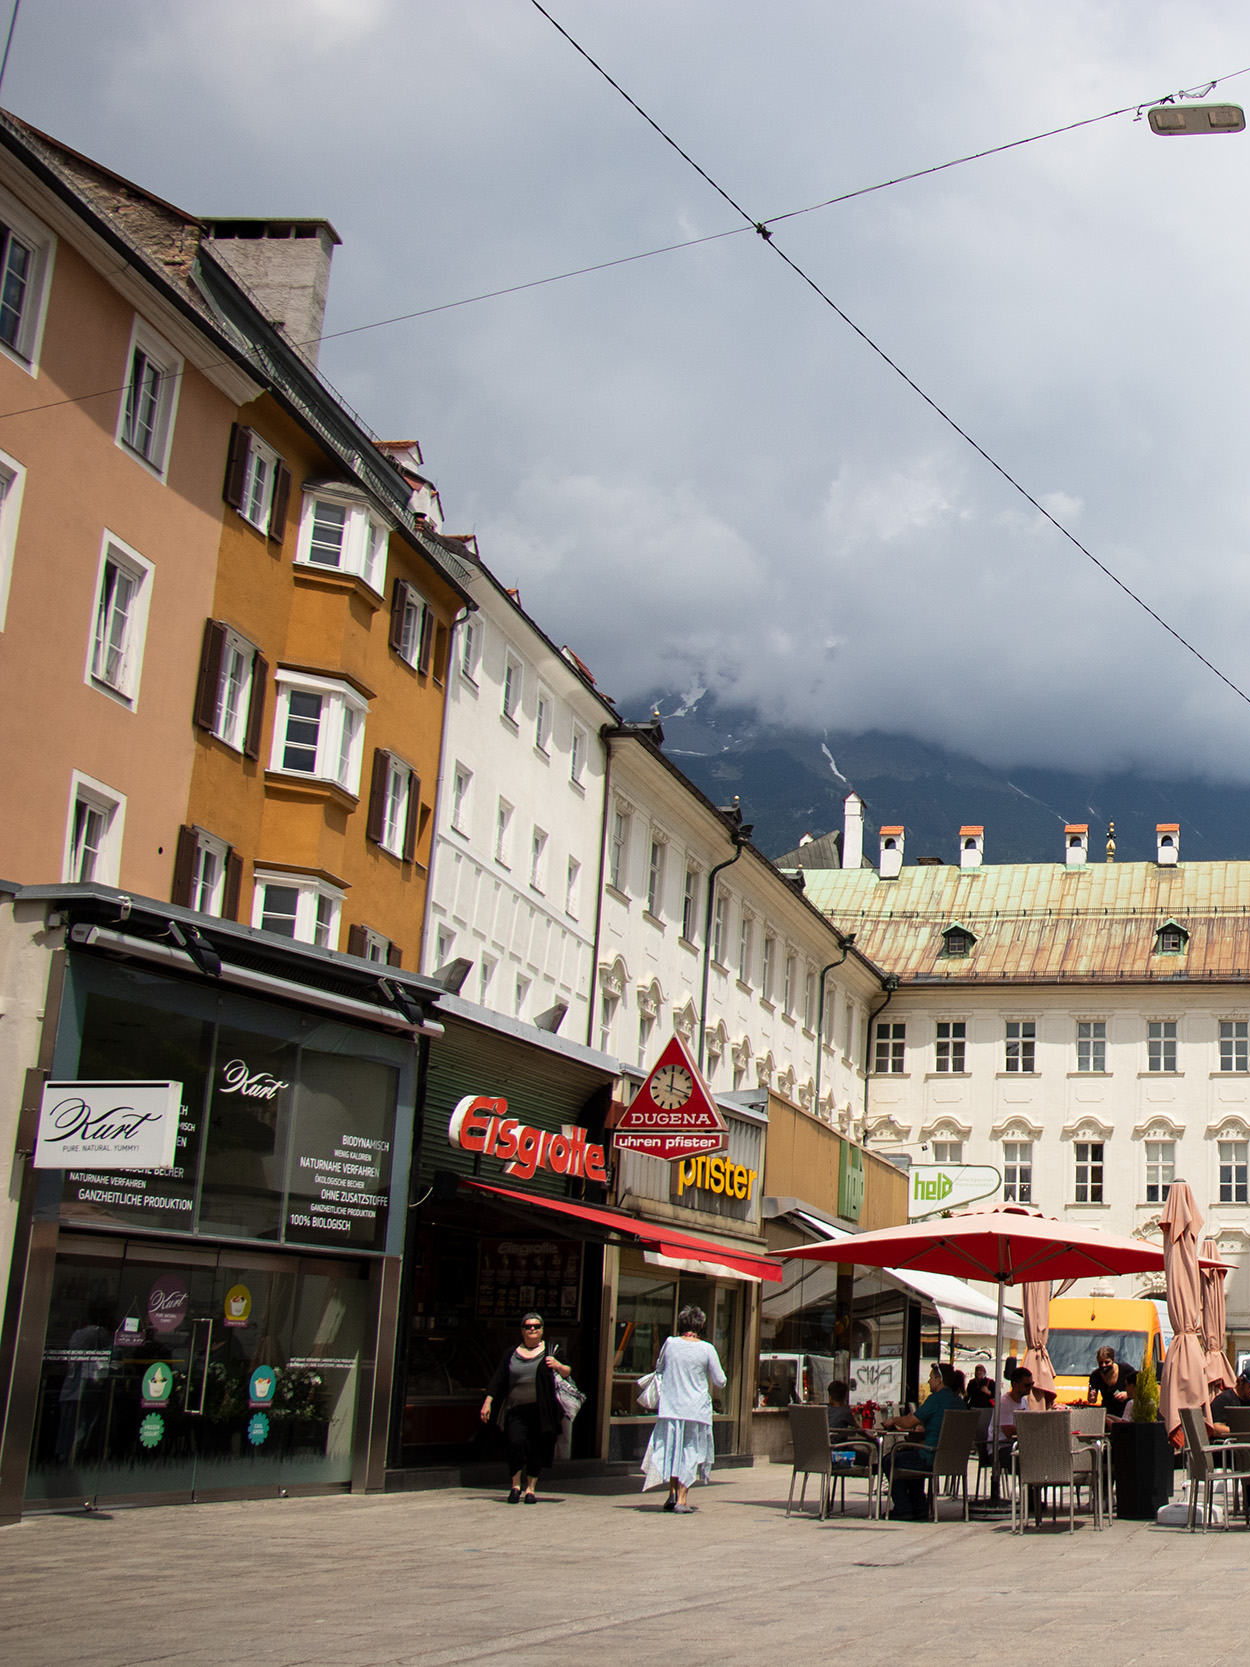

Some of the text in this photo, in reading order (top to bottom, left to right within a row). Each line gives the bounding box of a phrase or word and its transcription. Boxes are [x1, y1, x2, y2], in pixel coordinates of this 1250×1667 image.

[219, 1059, 289, 1099] Kurt
[44, 1098, 163, 1142] Kurt
[631, 1113, 711, 1125] DUGENA
[342, 1135, 389, 1152] BIODYNAMISCH
[453, 1095, 607, 1179] Eisgrotte
[619, 1136, 716, 1149] uhren pfister
[300, 1156, 380, 1178] NATURNAHE VERFAHREN
[69, 1172, 147, 1189] NATURNAHE VERFAHREN
[78, 1188, 194, 1210] GANZHEITLICHE PRODUKTION
[320, 1189, 388, 1206] OHNE ZUSATZSTOFFE
[290, 1214, 351, 1231] 100% BIOLOGISCH
[148, 1289, 189, 1313] Kurt
